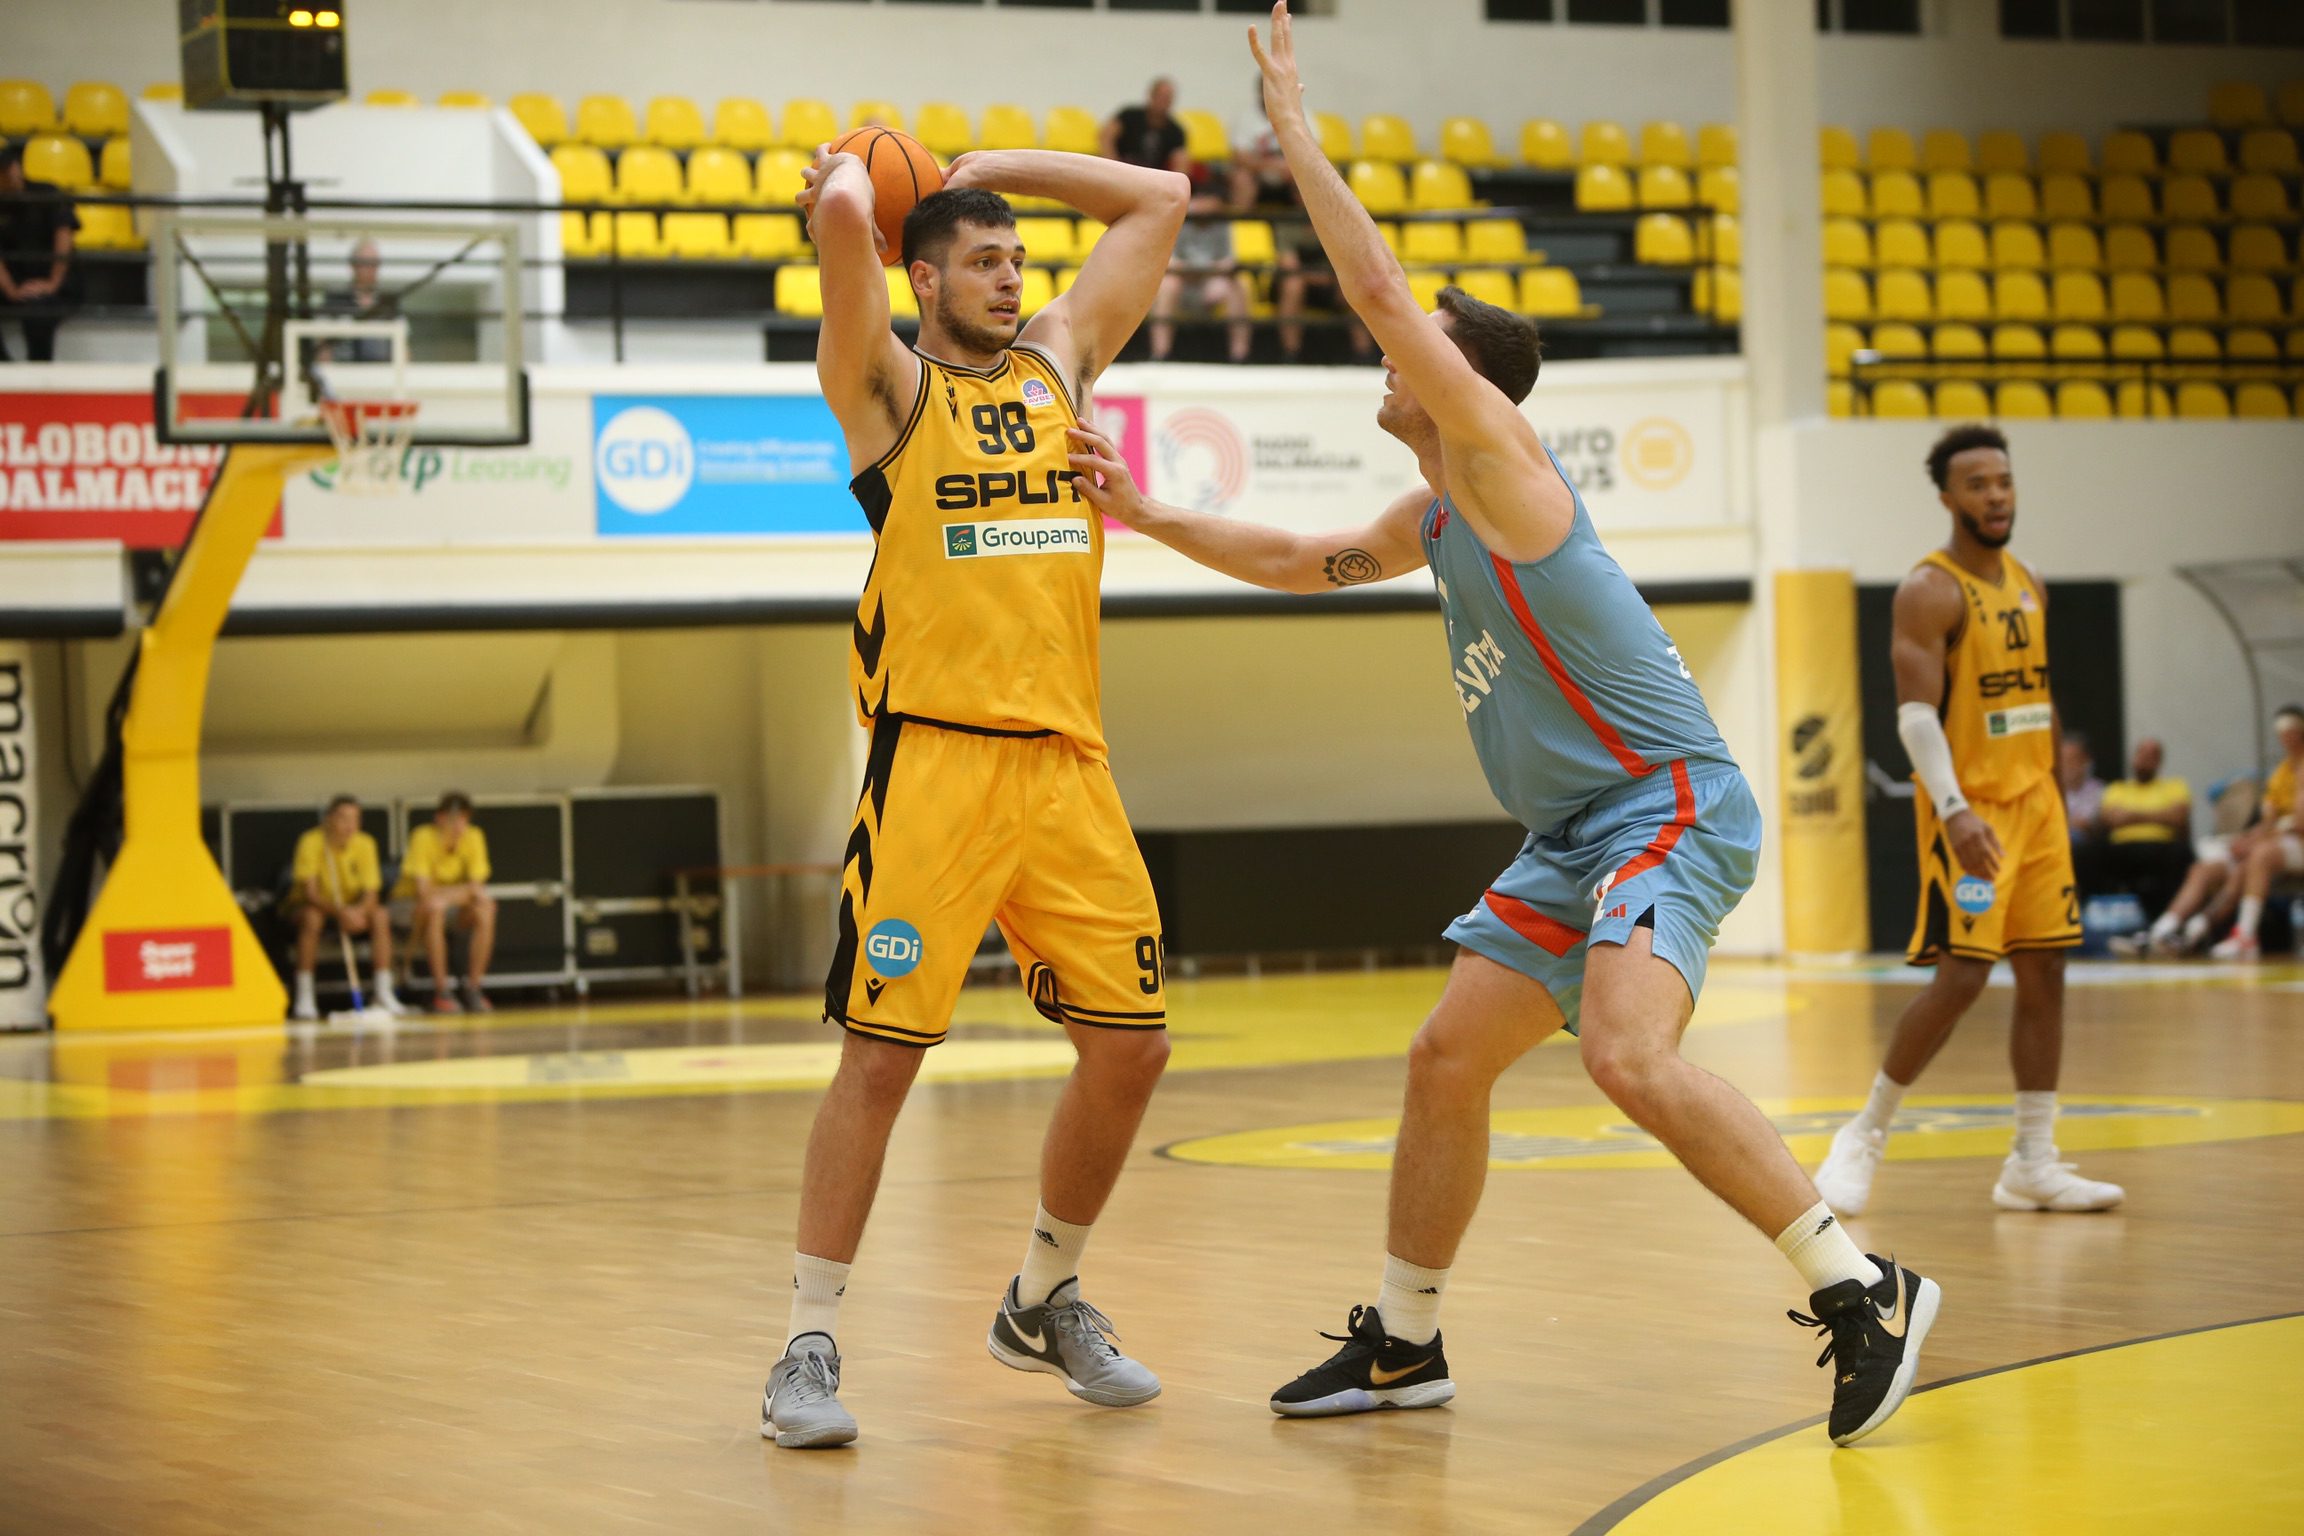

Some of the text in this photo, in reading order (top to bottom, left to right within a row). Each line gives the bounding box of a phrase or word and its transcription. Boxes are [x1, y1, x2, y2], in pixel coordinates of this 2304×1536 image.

[972, 402, 1035, 455] 98
[604, 437, 685, 479] GDi
[935, 470, 1083, 510] SPLIT
[982, 527, 1089, 549] Groupama
[2061, 885, 2081, 925] 2
[868, 935, 919, 962] GDi
